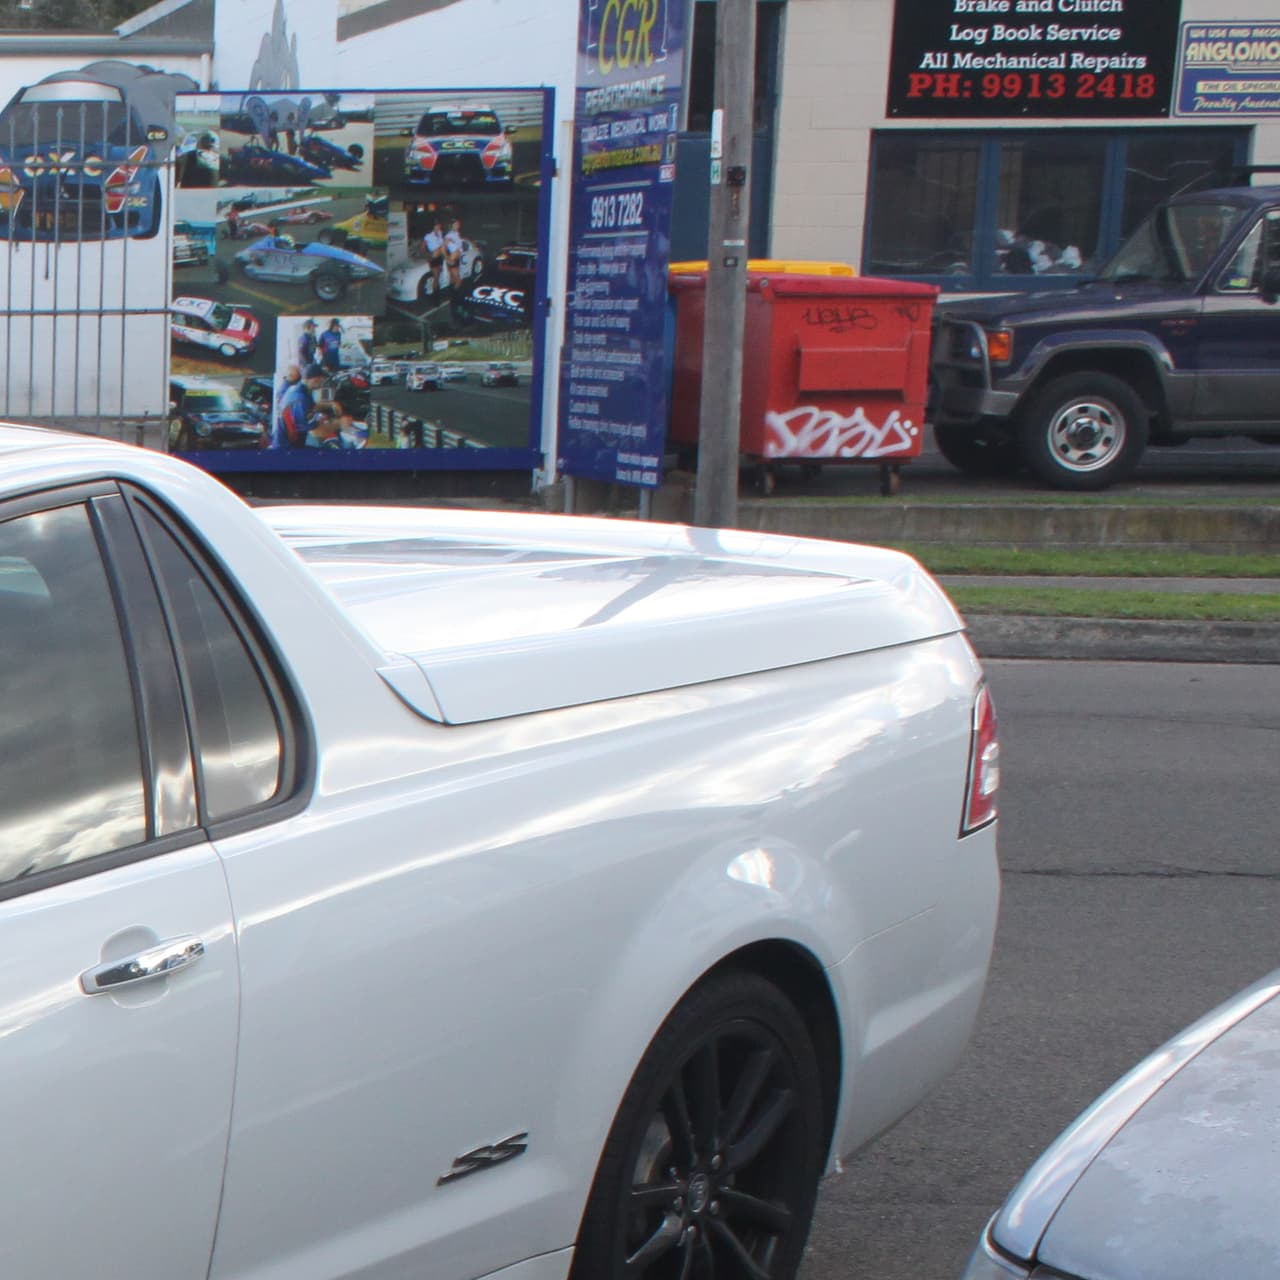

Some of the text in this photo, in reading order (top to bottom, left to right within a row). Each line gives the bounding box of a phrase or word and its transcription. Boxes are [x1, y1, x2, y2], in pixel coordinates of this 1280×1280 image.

[954, 0, 1124, 13] Brake and Clutch
[597, 0, 658, 75] CGR
[950, 23, 1122, 45] Log Book Service
[919, 51, 1147, 73] All Mechanical Repairs
[905, 73, 1156, 98] PH: 9913 2418
[591, 191, 644, 228] 9913 7282
[472, 285, 525, 307] CXC
